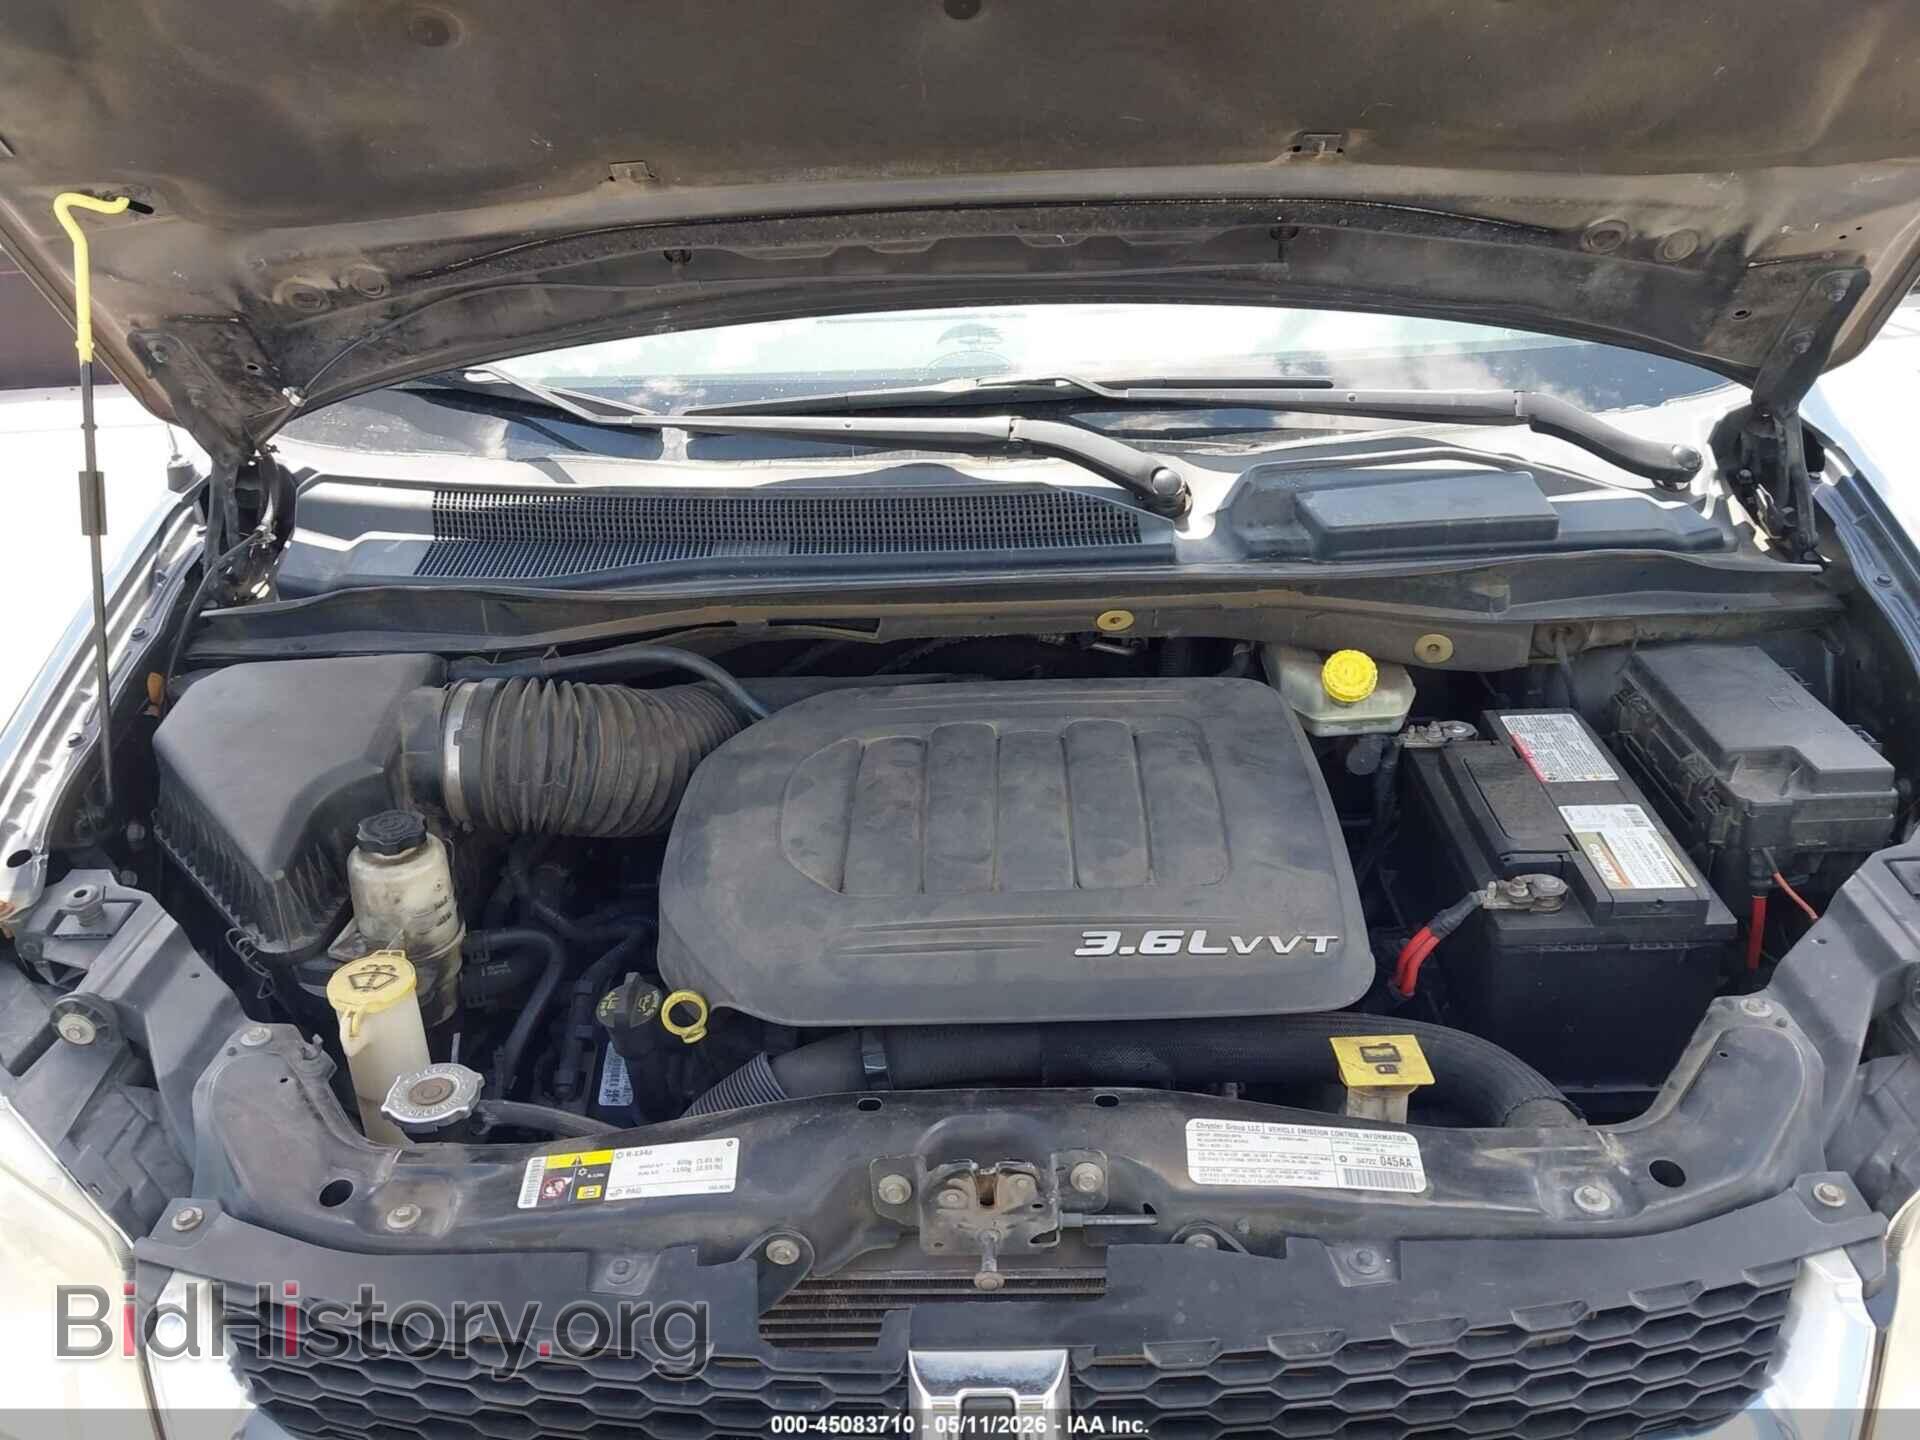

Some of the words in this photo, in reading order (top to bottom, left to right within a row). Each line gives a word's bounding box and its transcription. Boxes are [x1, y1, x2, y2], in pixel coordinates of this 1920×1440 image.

[1195, 1121, 1223, 1131] Chrysler
[1225, 1123, 1245, 1132] Group
[1247, 1124, 1261, 1132] LLC
[1268, 1126, 1294, 1135] VEHICLE
[1297, 1128, 1329, 1137] EMISSION
[1330, 1130, 1361, 1138] CONTROL
[1362, 1132, 1408, 1142] INFORMATION
